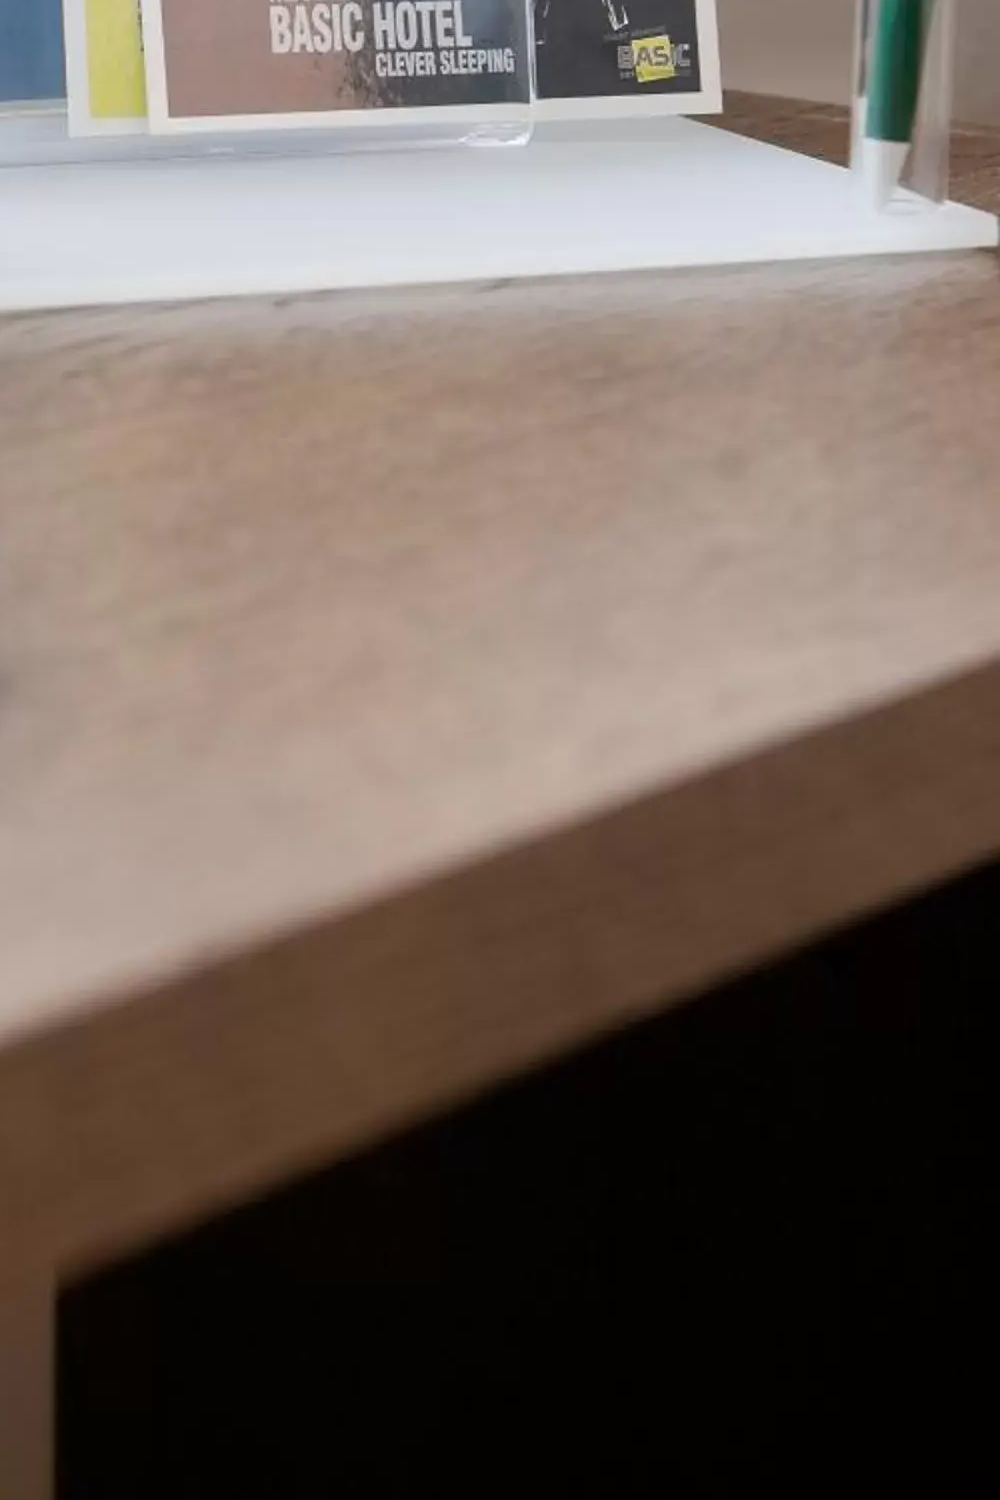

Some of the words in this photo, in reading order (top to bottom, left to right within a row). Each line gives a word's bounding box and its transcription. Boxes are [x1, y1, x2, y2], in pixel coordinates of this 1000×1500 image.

[269, 3, 365, 54] BASIC
[373, 0, 473, 51] HOTEL
[375, 50, 437, 77] CLEVER
[440, 47, 515, 76] SLEEPING
[617, 43, 690, 69] BASIC
